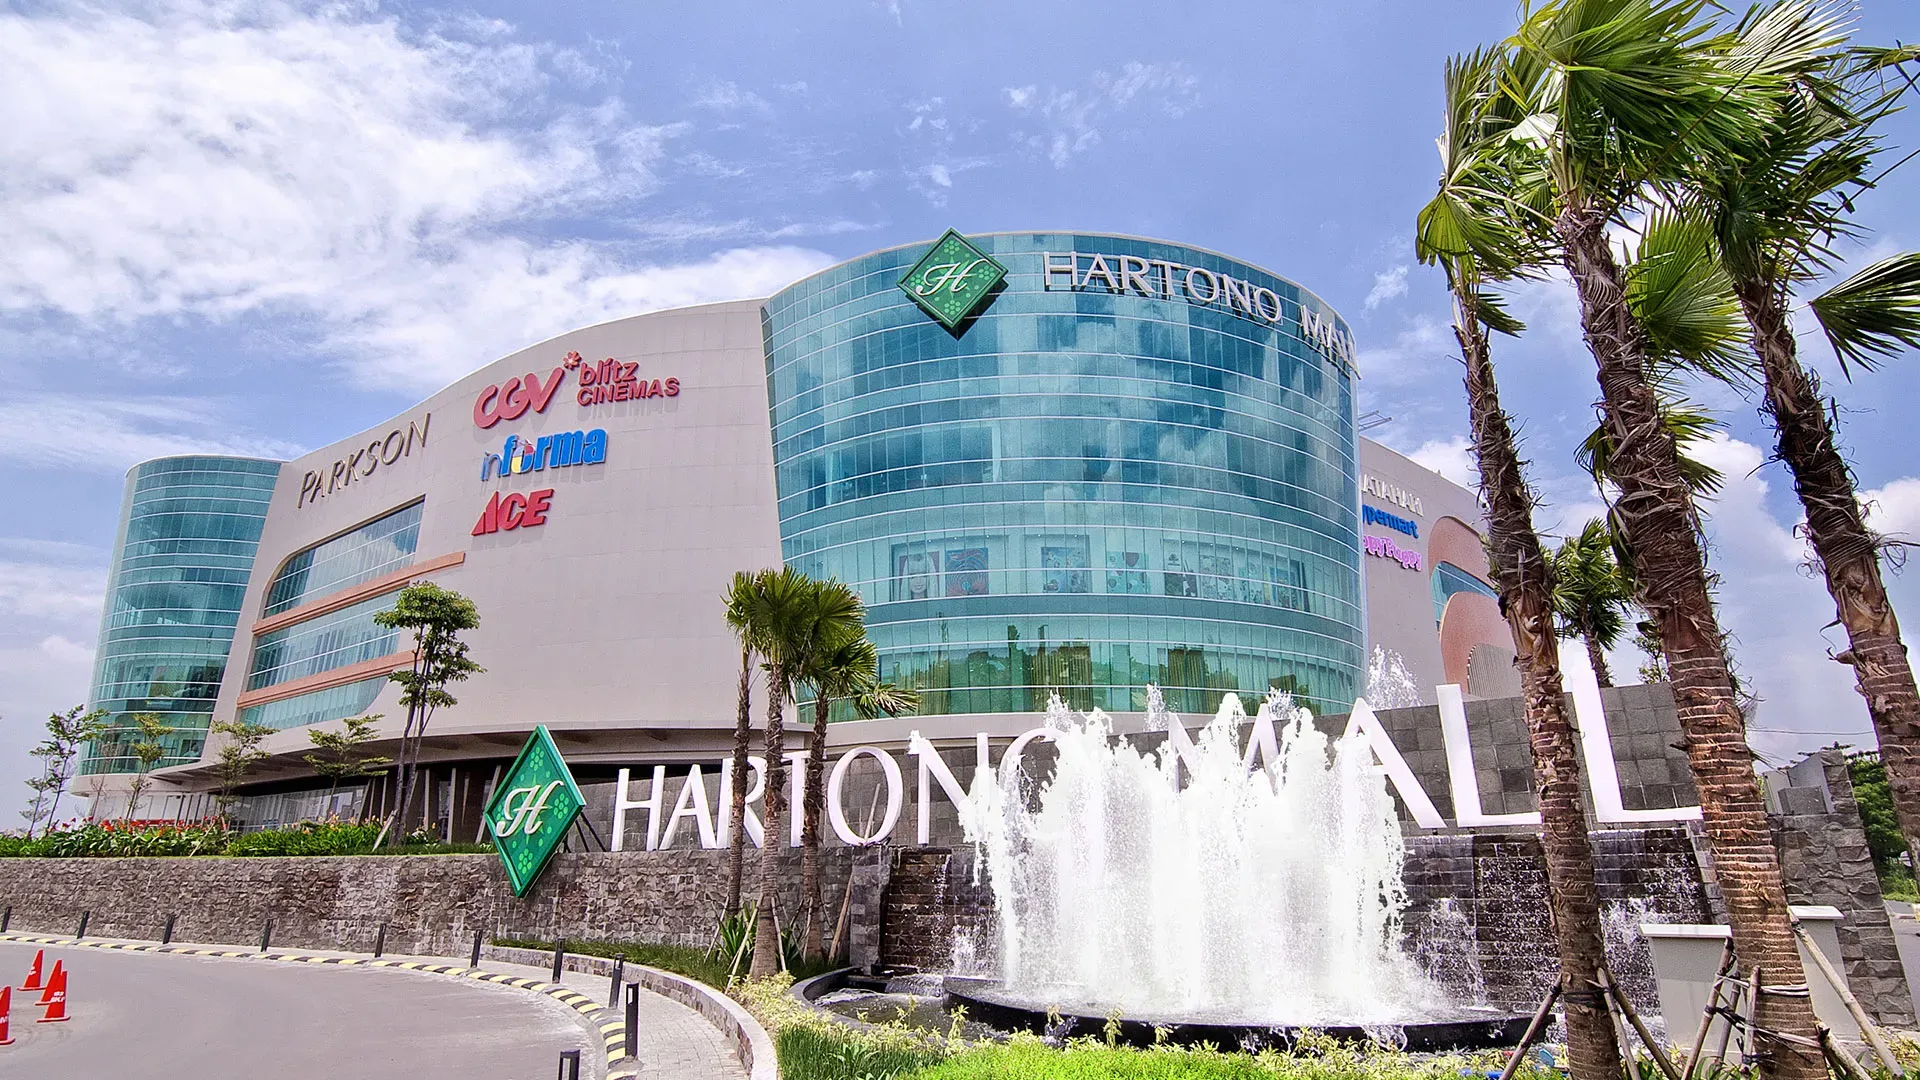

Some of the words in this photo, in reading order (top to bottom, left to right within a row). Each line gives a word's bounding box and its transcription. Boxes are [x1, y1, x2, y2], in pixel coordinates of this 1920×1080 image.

[1043, 251, 1283, 323] HARTONO
[1301, 304, 1362, 380] MALL
[473, 366, 565, 429] CGV
[577, 376, 680, 407] CINEMAS
[579, 357, 639, 387] blitz
[298, 412, 431, 509] PARKSON
[480, 428, 608, 481] informa
[471, 488, 554, 536] ACE
[496, 780, 565, 837] H
